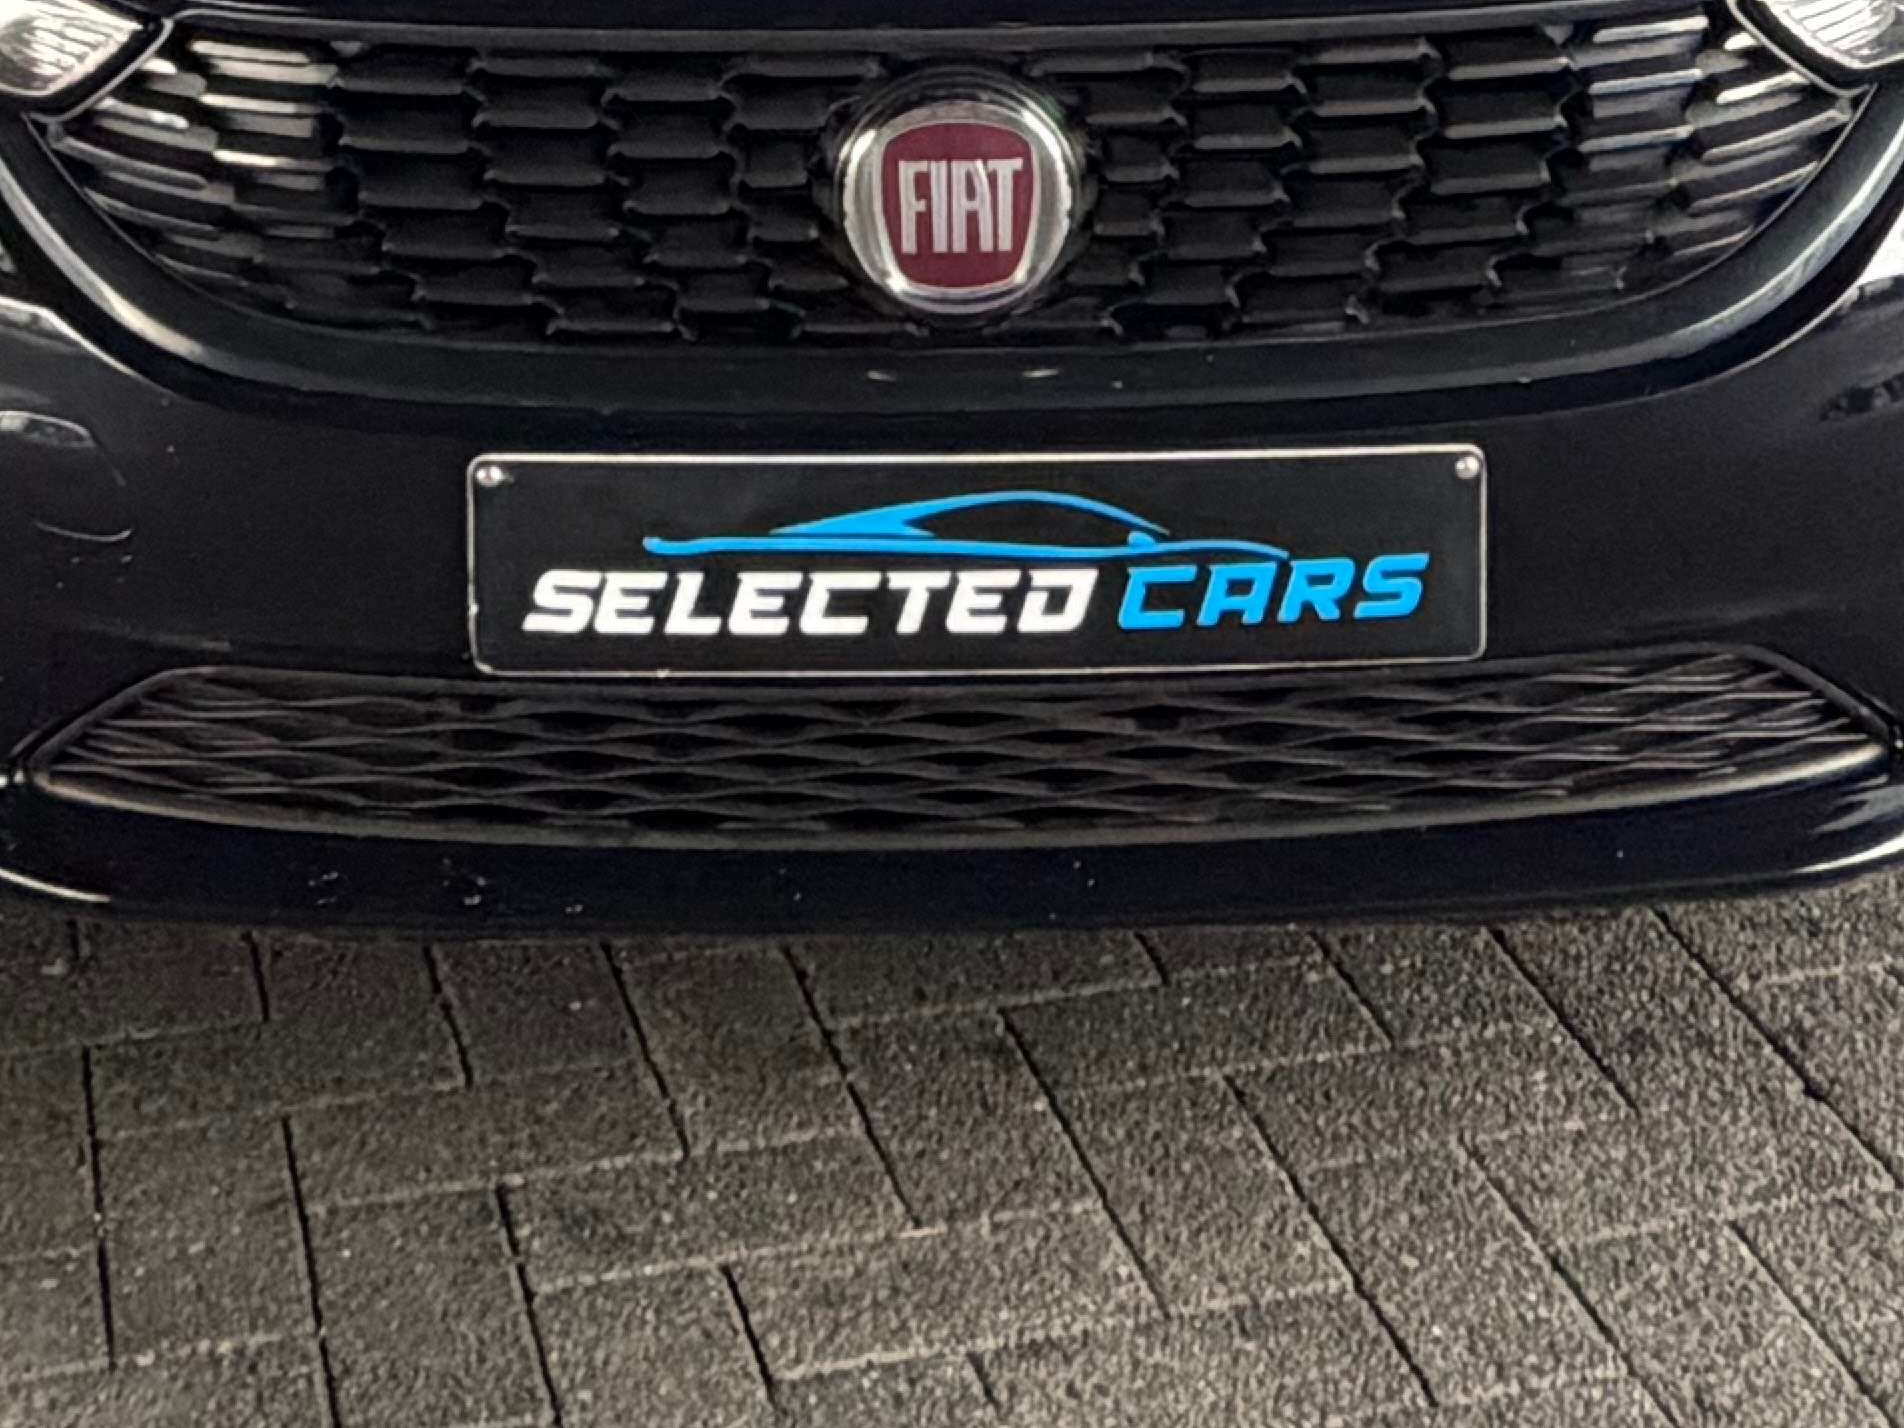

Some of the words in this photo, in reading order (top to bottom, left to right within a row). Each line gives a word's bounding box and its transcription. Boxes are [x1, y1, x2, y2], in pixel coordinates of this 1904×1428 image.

[897, 157, 1024, 255] FIAT
[521, 567, 1099, 636] SELECTED
[1117, 552, 1430, 631] CARS
